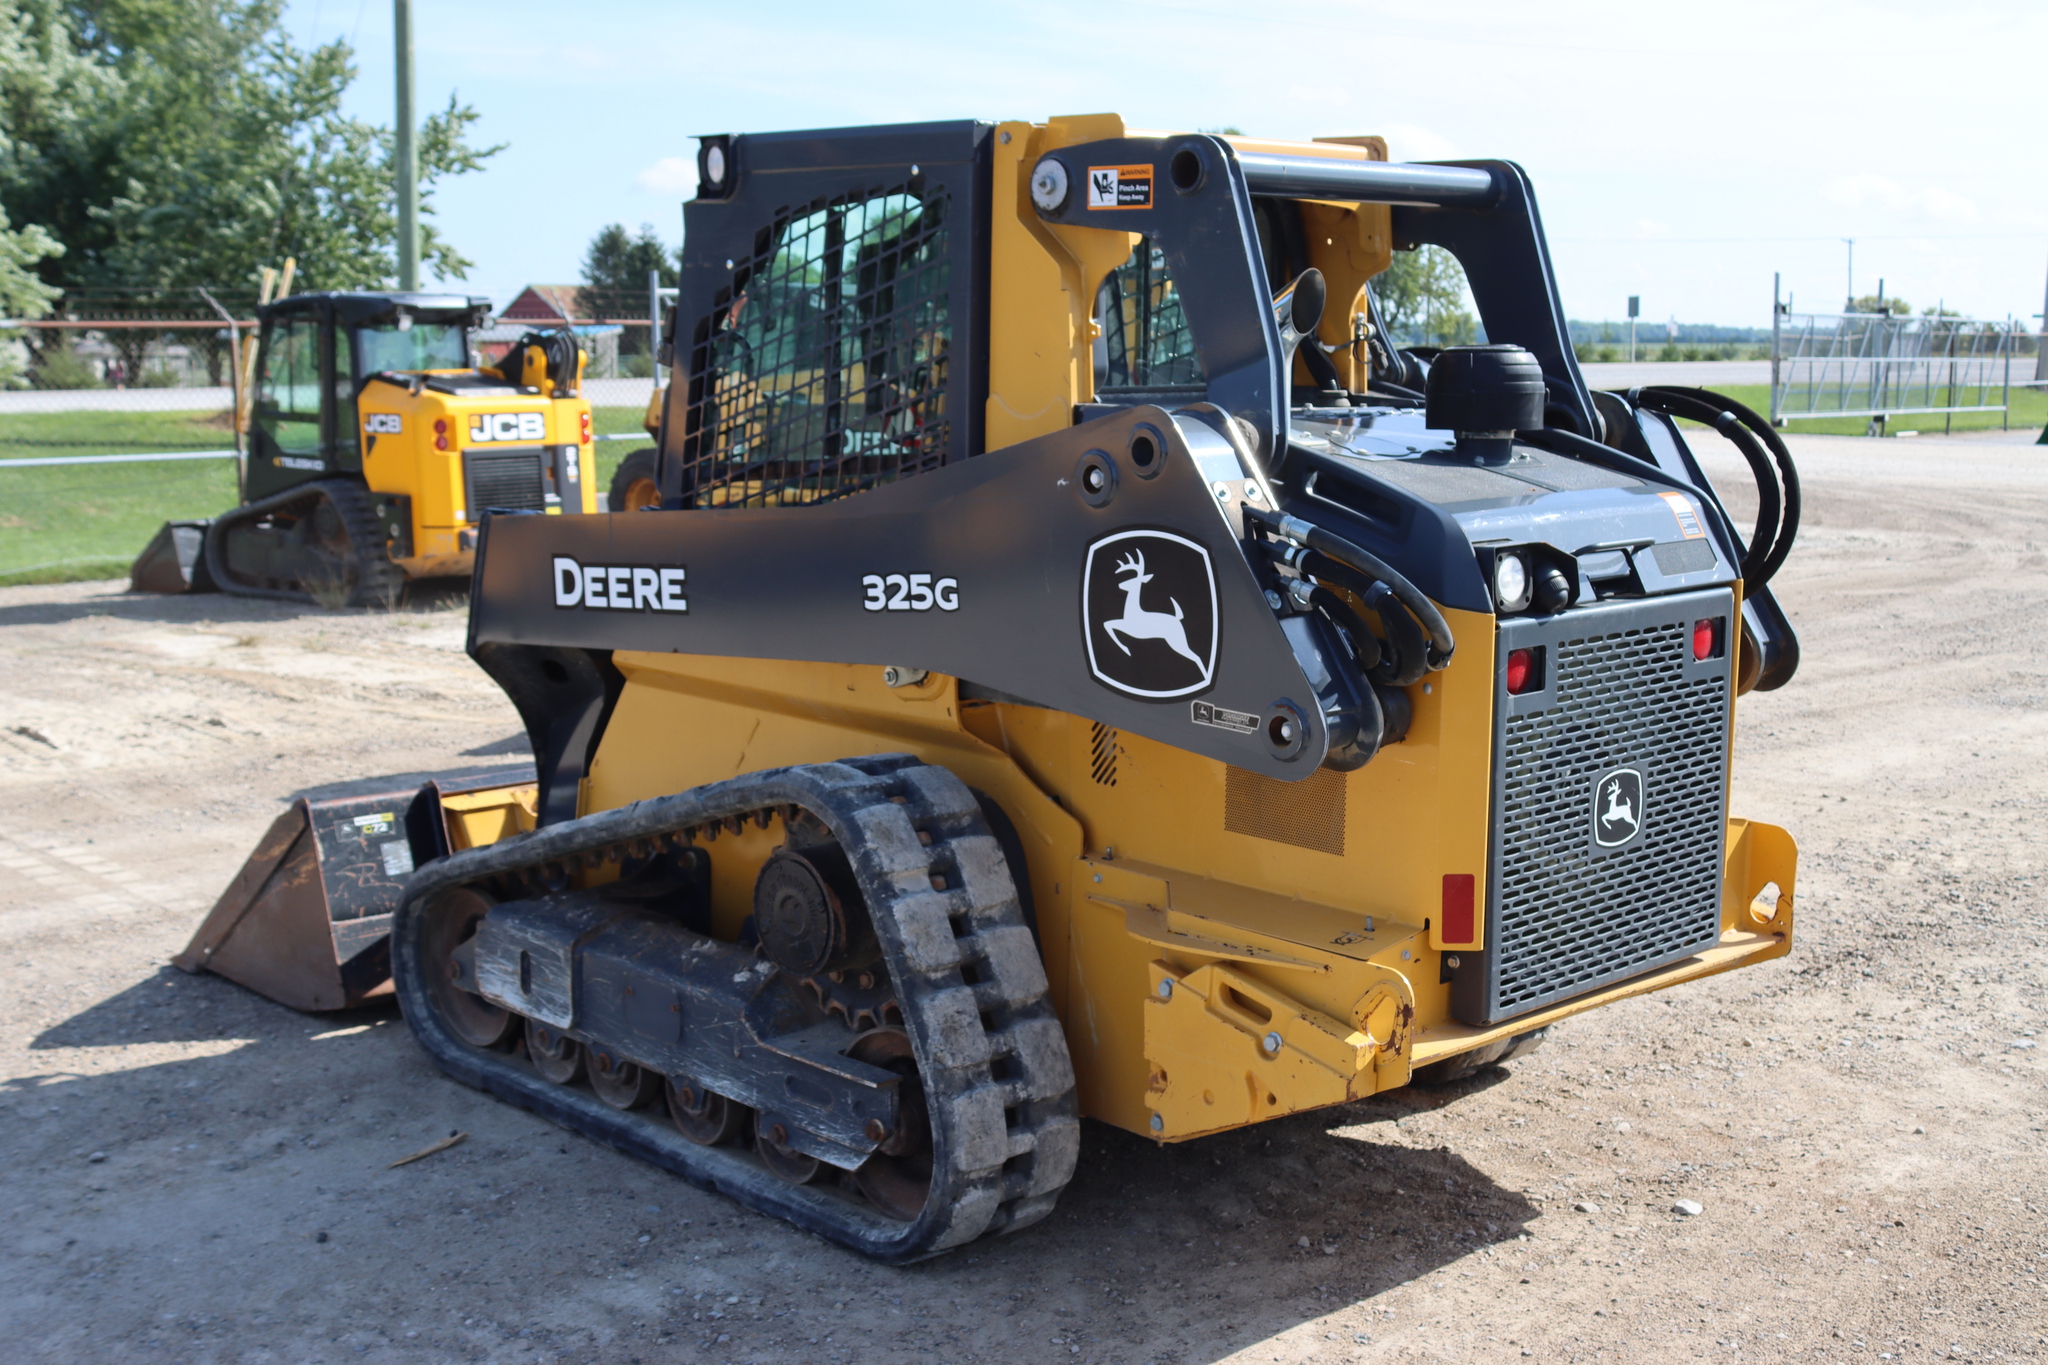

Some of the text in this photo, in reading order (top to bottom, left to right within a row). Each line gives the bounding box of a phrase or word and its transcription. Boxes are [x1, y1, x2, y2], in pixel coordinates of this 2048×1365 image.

[1118, 183, 1149, 192] Pinch Area
[1118, 193, 1145, 202] Keep Away
[364, 413, 402, 433] JCB
[470, 412, 545, 441] JCB
[553, 557, 687, 611] DEERE
[863, 573, 959, 611] 325G
